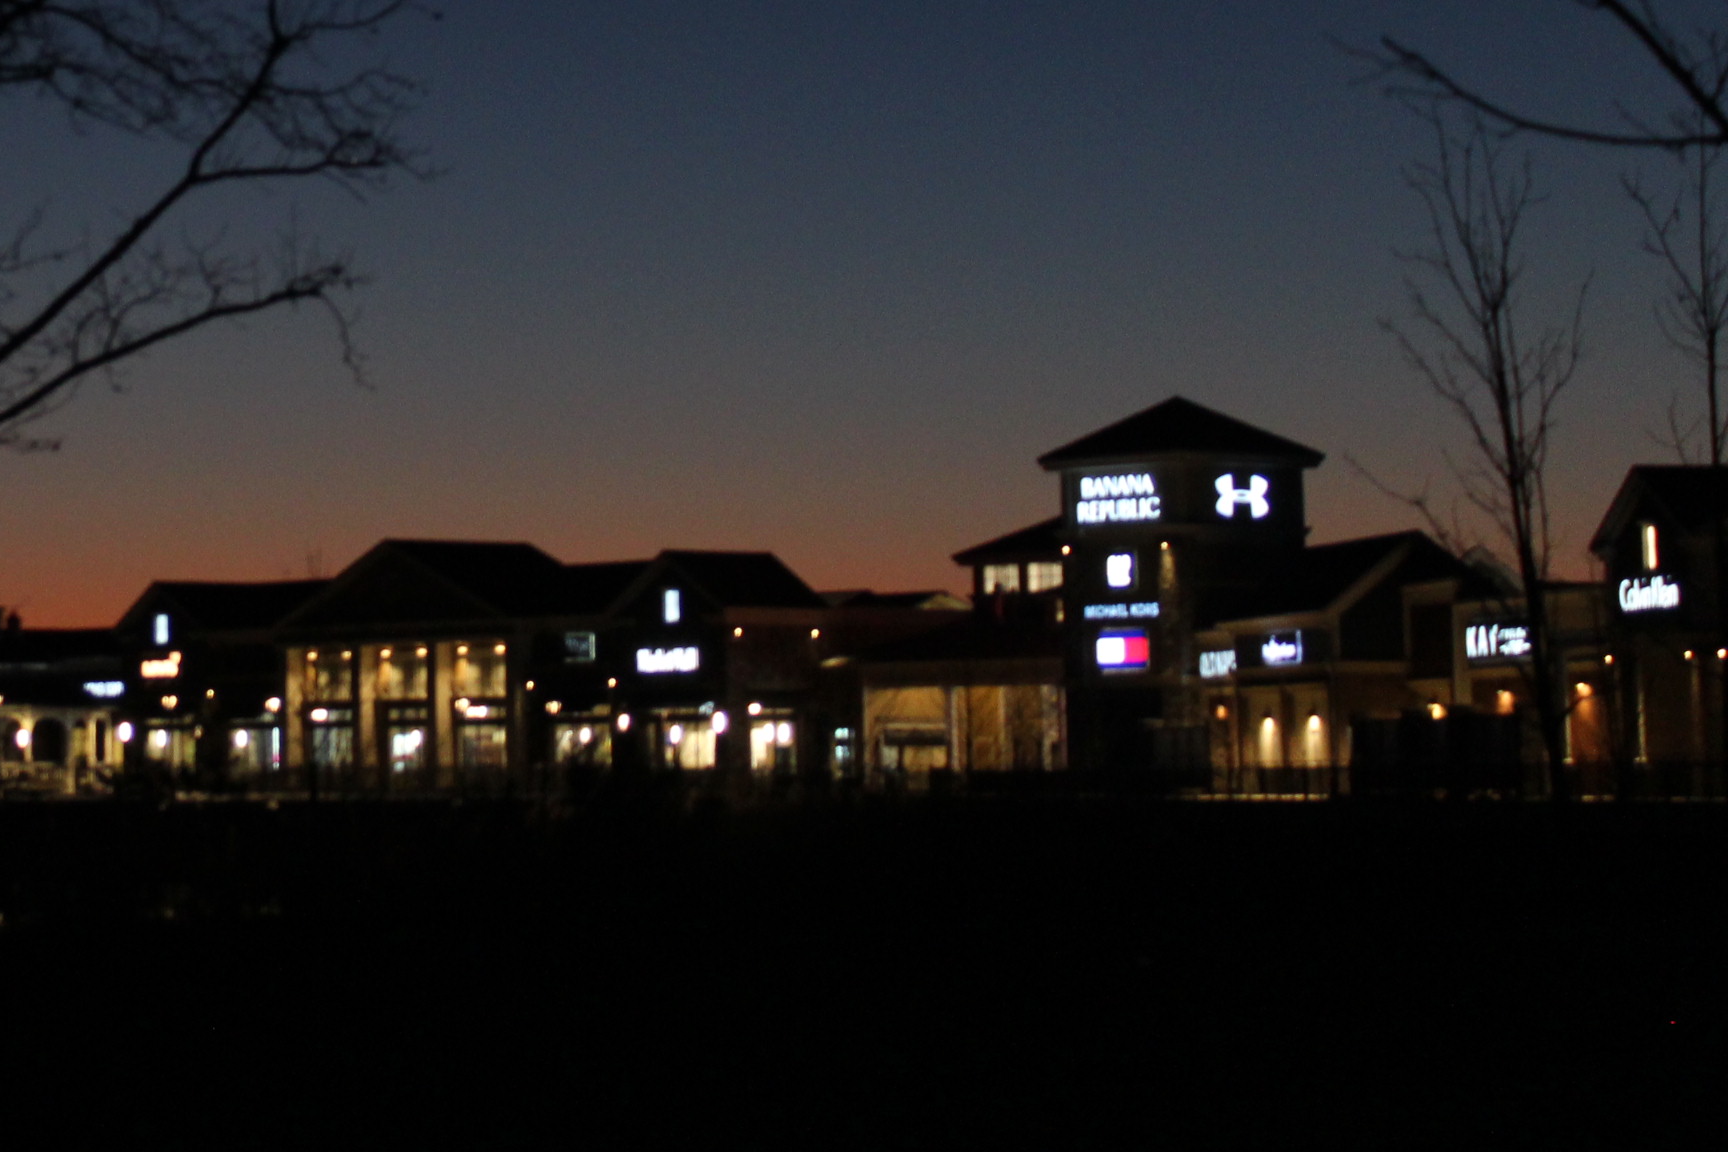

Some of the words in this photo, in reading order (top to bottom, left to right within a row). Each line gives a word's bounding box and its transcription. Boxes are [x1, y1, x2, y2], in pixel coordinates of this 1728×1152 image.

[1080, 473, 1156, 499] BANANA
[1076, 497, 1161, 524] REPUBLIC
[1465, 623, 1499, 658] KAY
